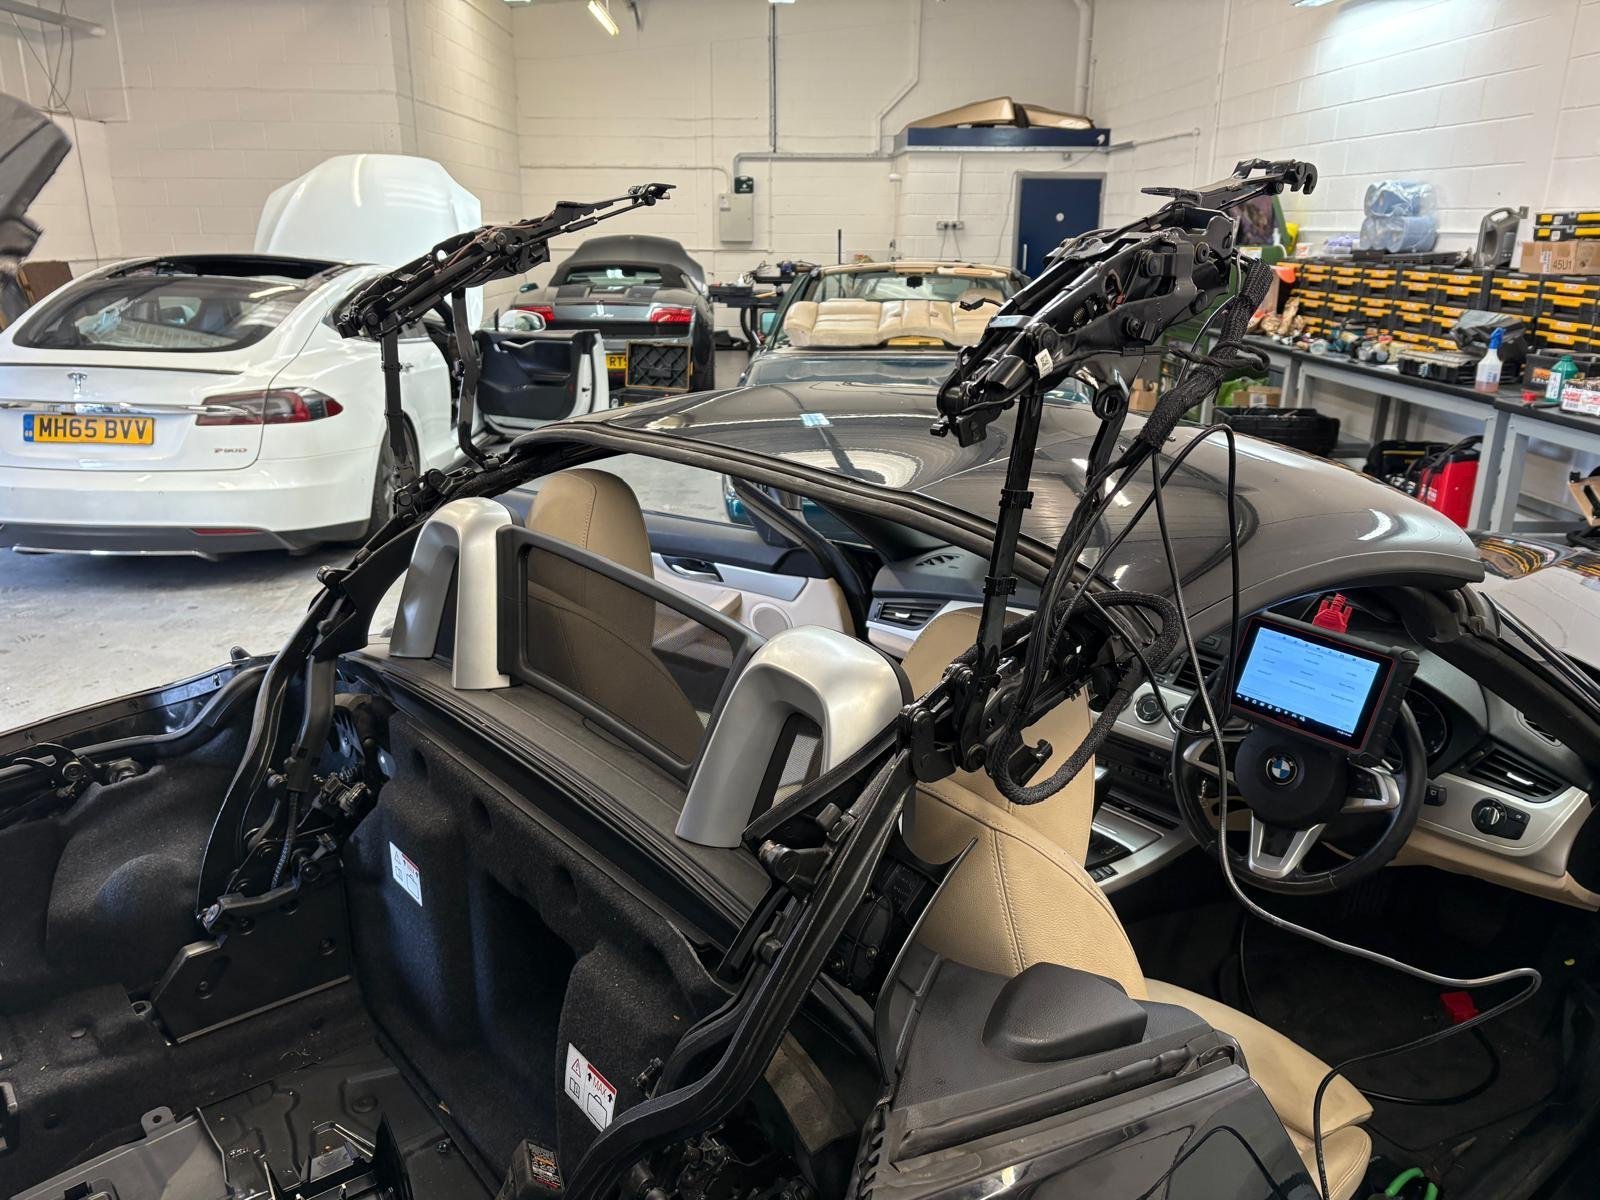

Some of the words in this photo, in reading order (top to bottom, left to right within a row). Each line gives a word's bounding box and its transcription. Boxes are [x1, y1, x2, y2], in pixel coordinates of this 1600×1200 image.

[39, 417, 97, 438] MH65
[104, 419, 147, 439] BVV
[592, 1076, 607, 1098] MAX
